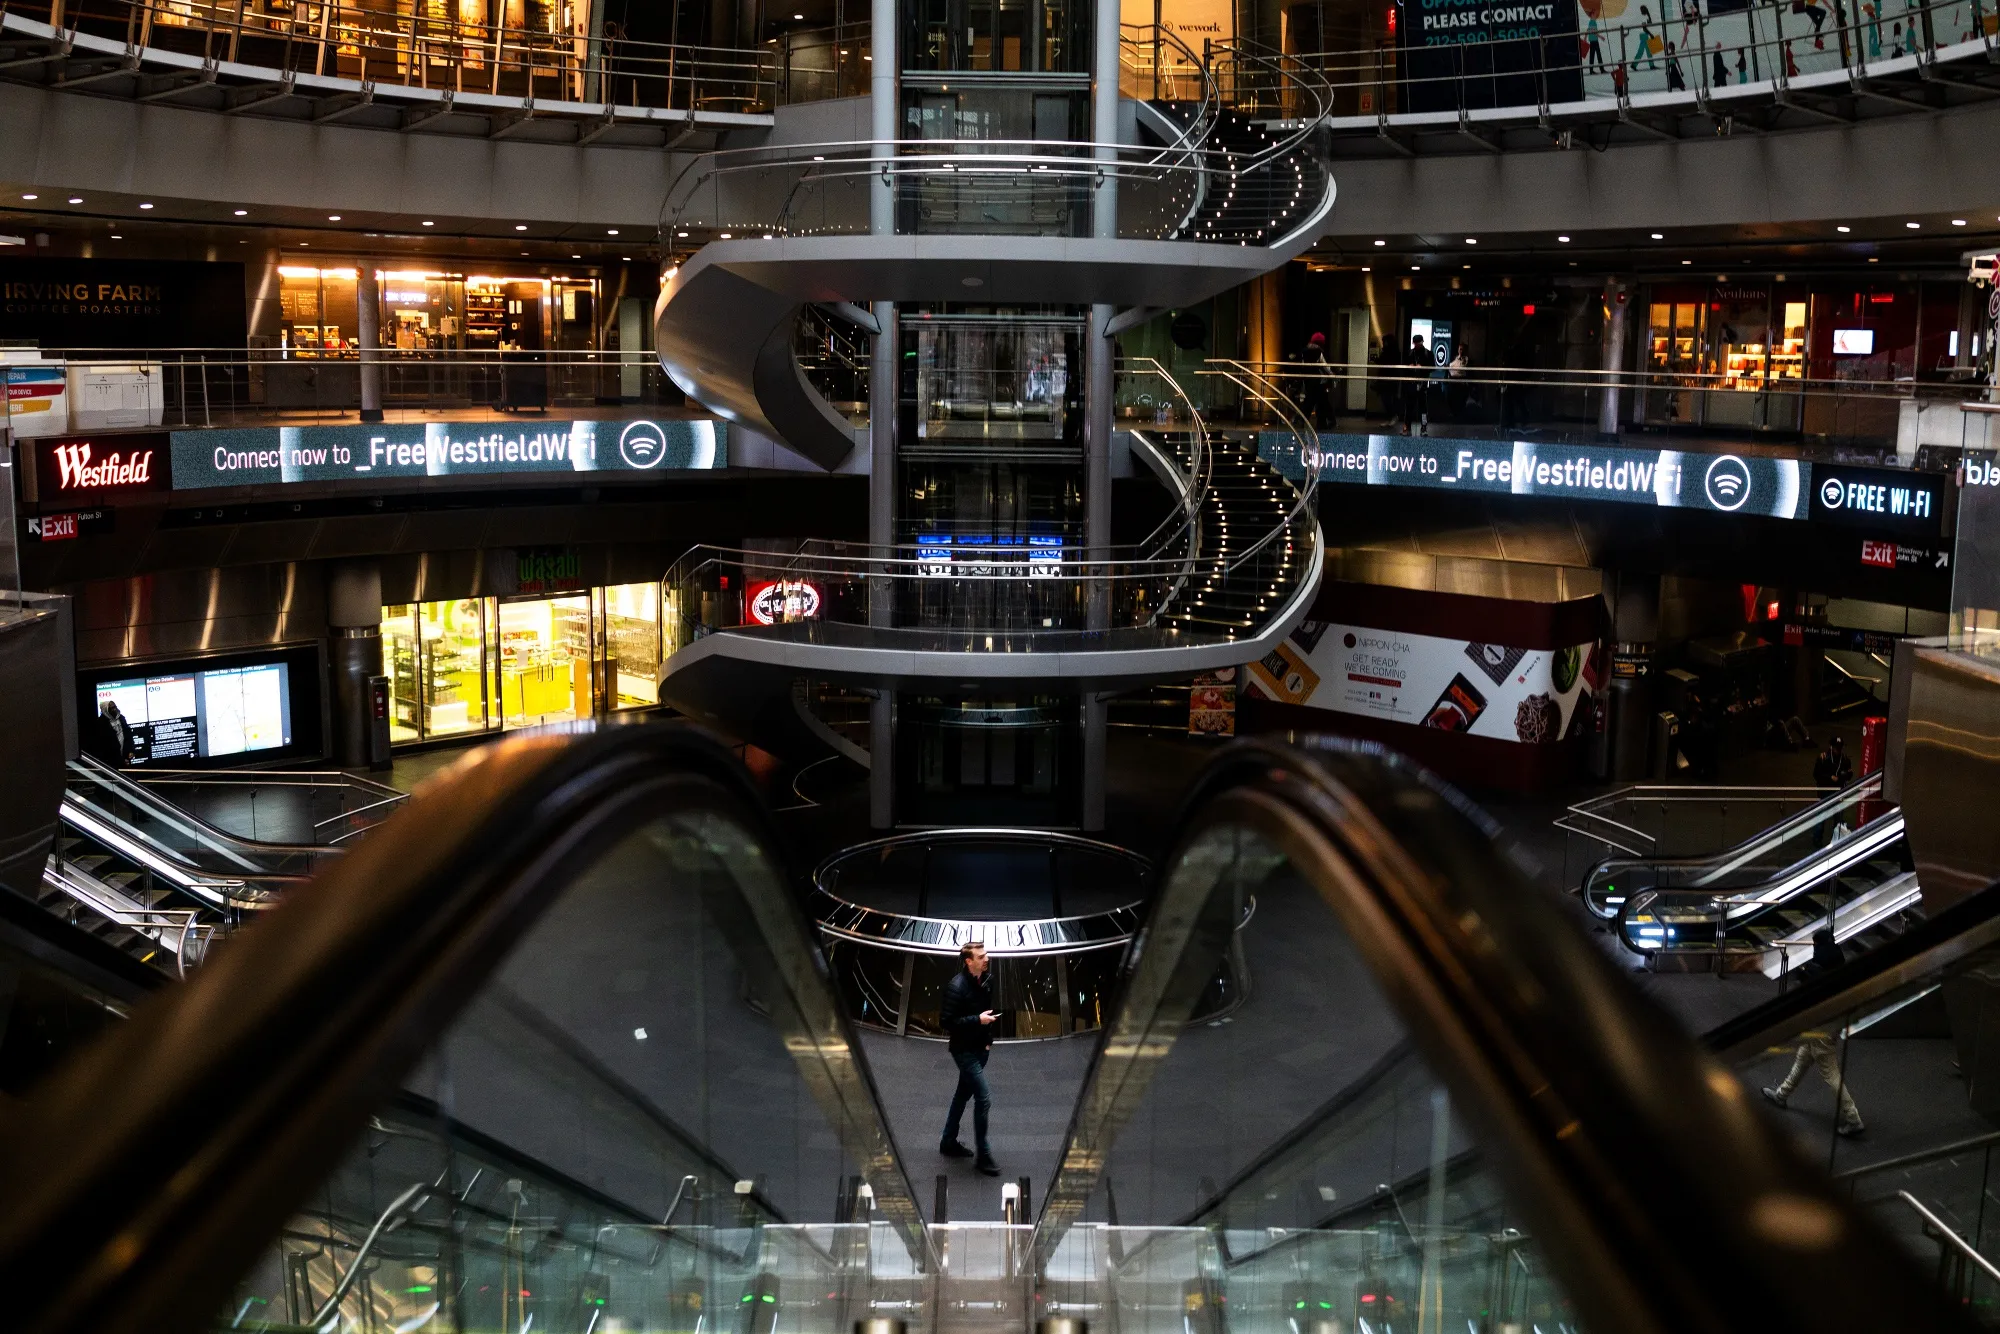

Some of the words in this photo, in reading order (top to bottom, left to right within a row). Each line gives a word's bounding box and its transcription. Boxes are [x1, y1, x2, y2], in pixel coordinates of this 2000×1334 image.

[1423, 11, 1476, 30] PLEASE
[1481, 4, 1553, 24] CONTACT
[1179, 22, 1221, 32] wework
[4, 282, 89, 300] IRVING
[98, 283, 161, 301] FARM
[1715, 287, 1767, 301] Neuhaus
[6, 303, 70, 314] COFFEE
[79, 304, 161, 315] ROASTERS
[214, 446, 285, 471] Connect
[292, 448, 328, 466] now
[332, 444, 350, 464] to
[1378, 454, 1414, 473] now
[1419, 454, 1437, 474] to
[54, 443, 153, 490] Westfield
[1847, 483, 1887, 513] FREE
[1890, 487, 1931, 518] WI-FI
[77, 512, 94, 520] Fulton
[96, 511, 102, 519] St
[41, 515, 74, 537] Exit
[1861, 540, 1893, 564] Exit
[1896, 545, 1924, 558] Broadway
[1896, 553, 1910, 562] John
[520, 548, 581, 581] wasabi
[1784, 624, 1802, 634] Exit
[1804, 626, 1819, 634] John
[1821, 627, 1840, 636] Street
[1358, 638, 1390, 651] NIPPON
[1392, 642, 1411, 654] CHA
[1352, 653, 1369, 664] GET
[1372, 656, 1399, 668] READY
[1344, 662, 1370, 674] WE'RE
[1372, 666, 1407, 680] COMING
